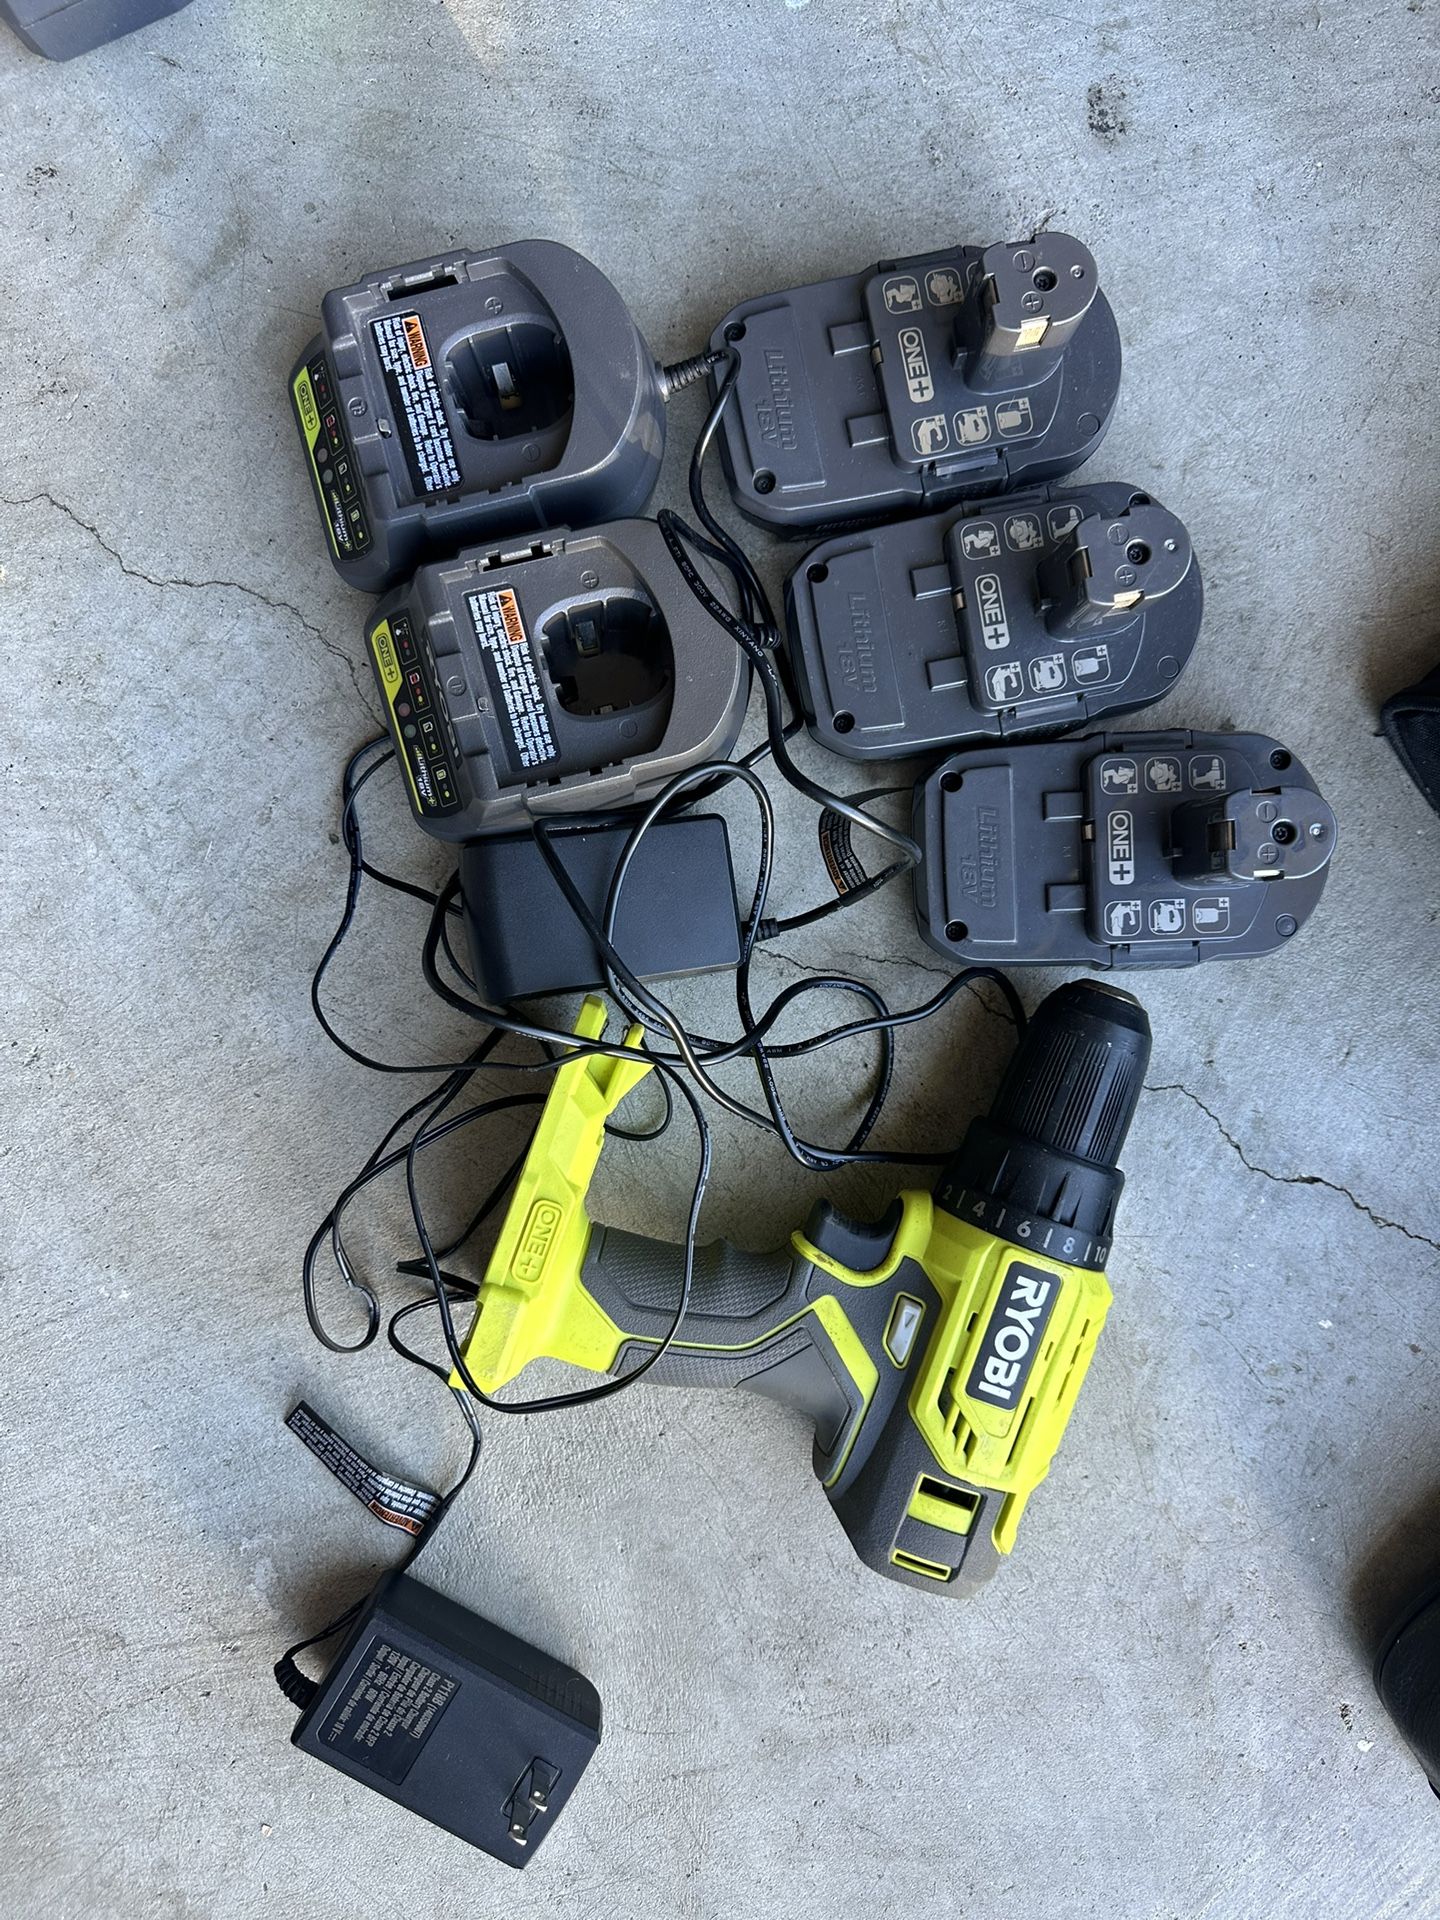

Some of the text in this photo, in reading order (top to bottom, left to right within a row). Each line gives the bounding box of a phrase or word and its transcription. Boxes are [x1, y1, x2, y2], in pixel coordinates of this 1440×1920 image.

[407, 330, 428, 366] WARNING
[901, 332, 931, 398] ONE+
[298, 385, 315, 427] ONE+
[754, 398, 779, 450] 18V
[764, 348, 801, 451] Lithium
[501, 605, 522, 642] WARNING
[733, 624, 765, 658] XINYANG
[846, 589, 883, 694] Lithium
[977, 576, 1007, 646] ONE+
[378, 637, 396, 679] ONE+
[836, 641, 859, 688] 18V
[425, 645, 460, 758] RYOBI
[960, 854, 977, 903] 18V
[977, 805, 1000, 908] Lithium
[1111, 815, 1132, 882] ONE+
[521, 1207, 557, 1276] ONE+
[942, 1186, 1106, 1263] 2 4 6 8 10
[978, 1274, 1050, 1401] RYOBI
[432, 1679, 455, 1706] P118B
